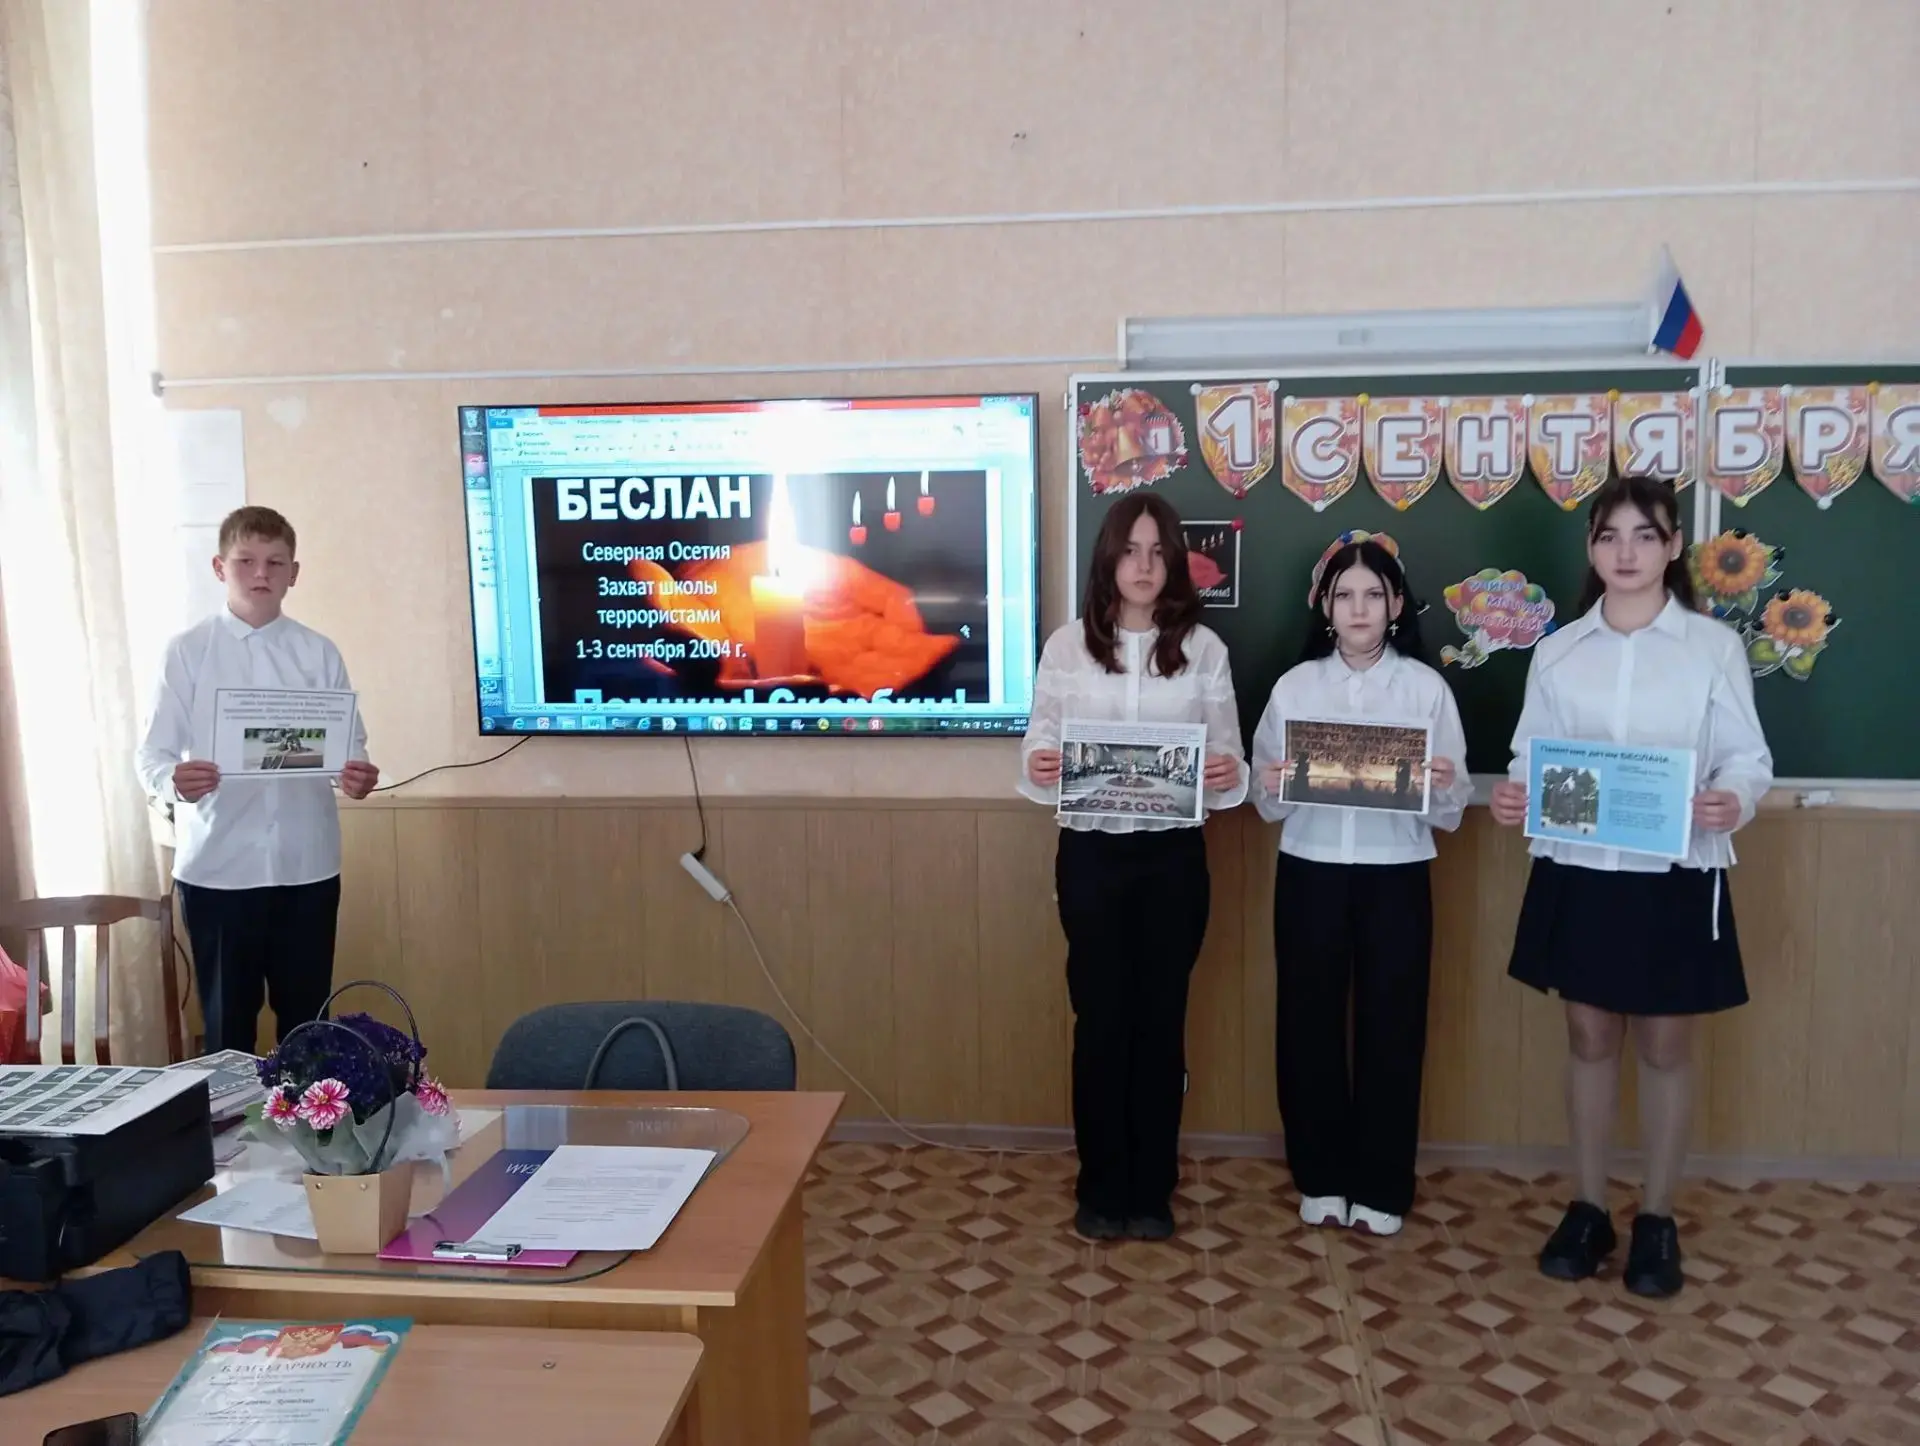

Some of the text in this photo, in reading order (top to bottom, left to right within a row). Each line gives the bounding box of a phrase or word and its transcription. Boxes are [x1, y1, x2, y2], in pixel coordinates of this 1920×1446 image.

[1206, 393, 1260, 471] 1
[557, 476, 751, 521] БЕСЛАН
[582, 541, 731, 563] Северная Осетия
[598, 577, 717, 598] Захват школы
[597, 607, 721, 628] террористами
[576, 639, 747, 663] 1-3 сентября 2004 г.
